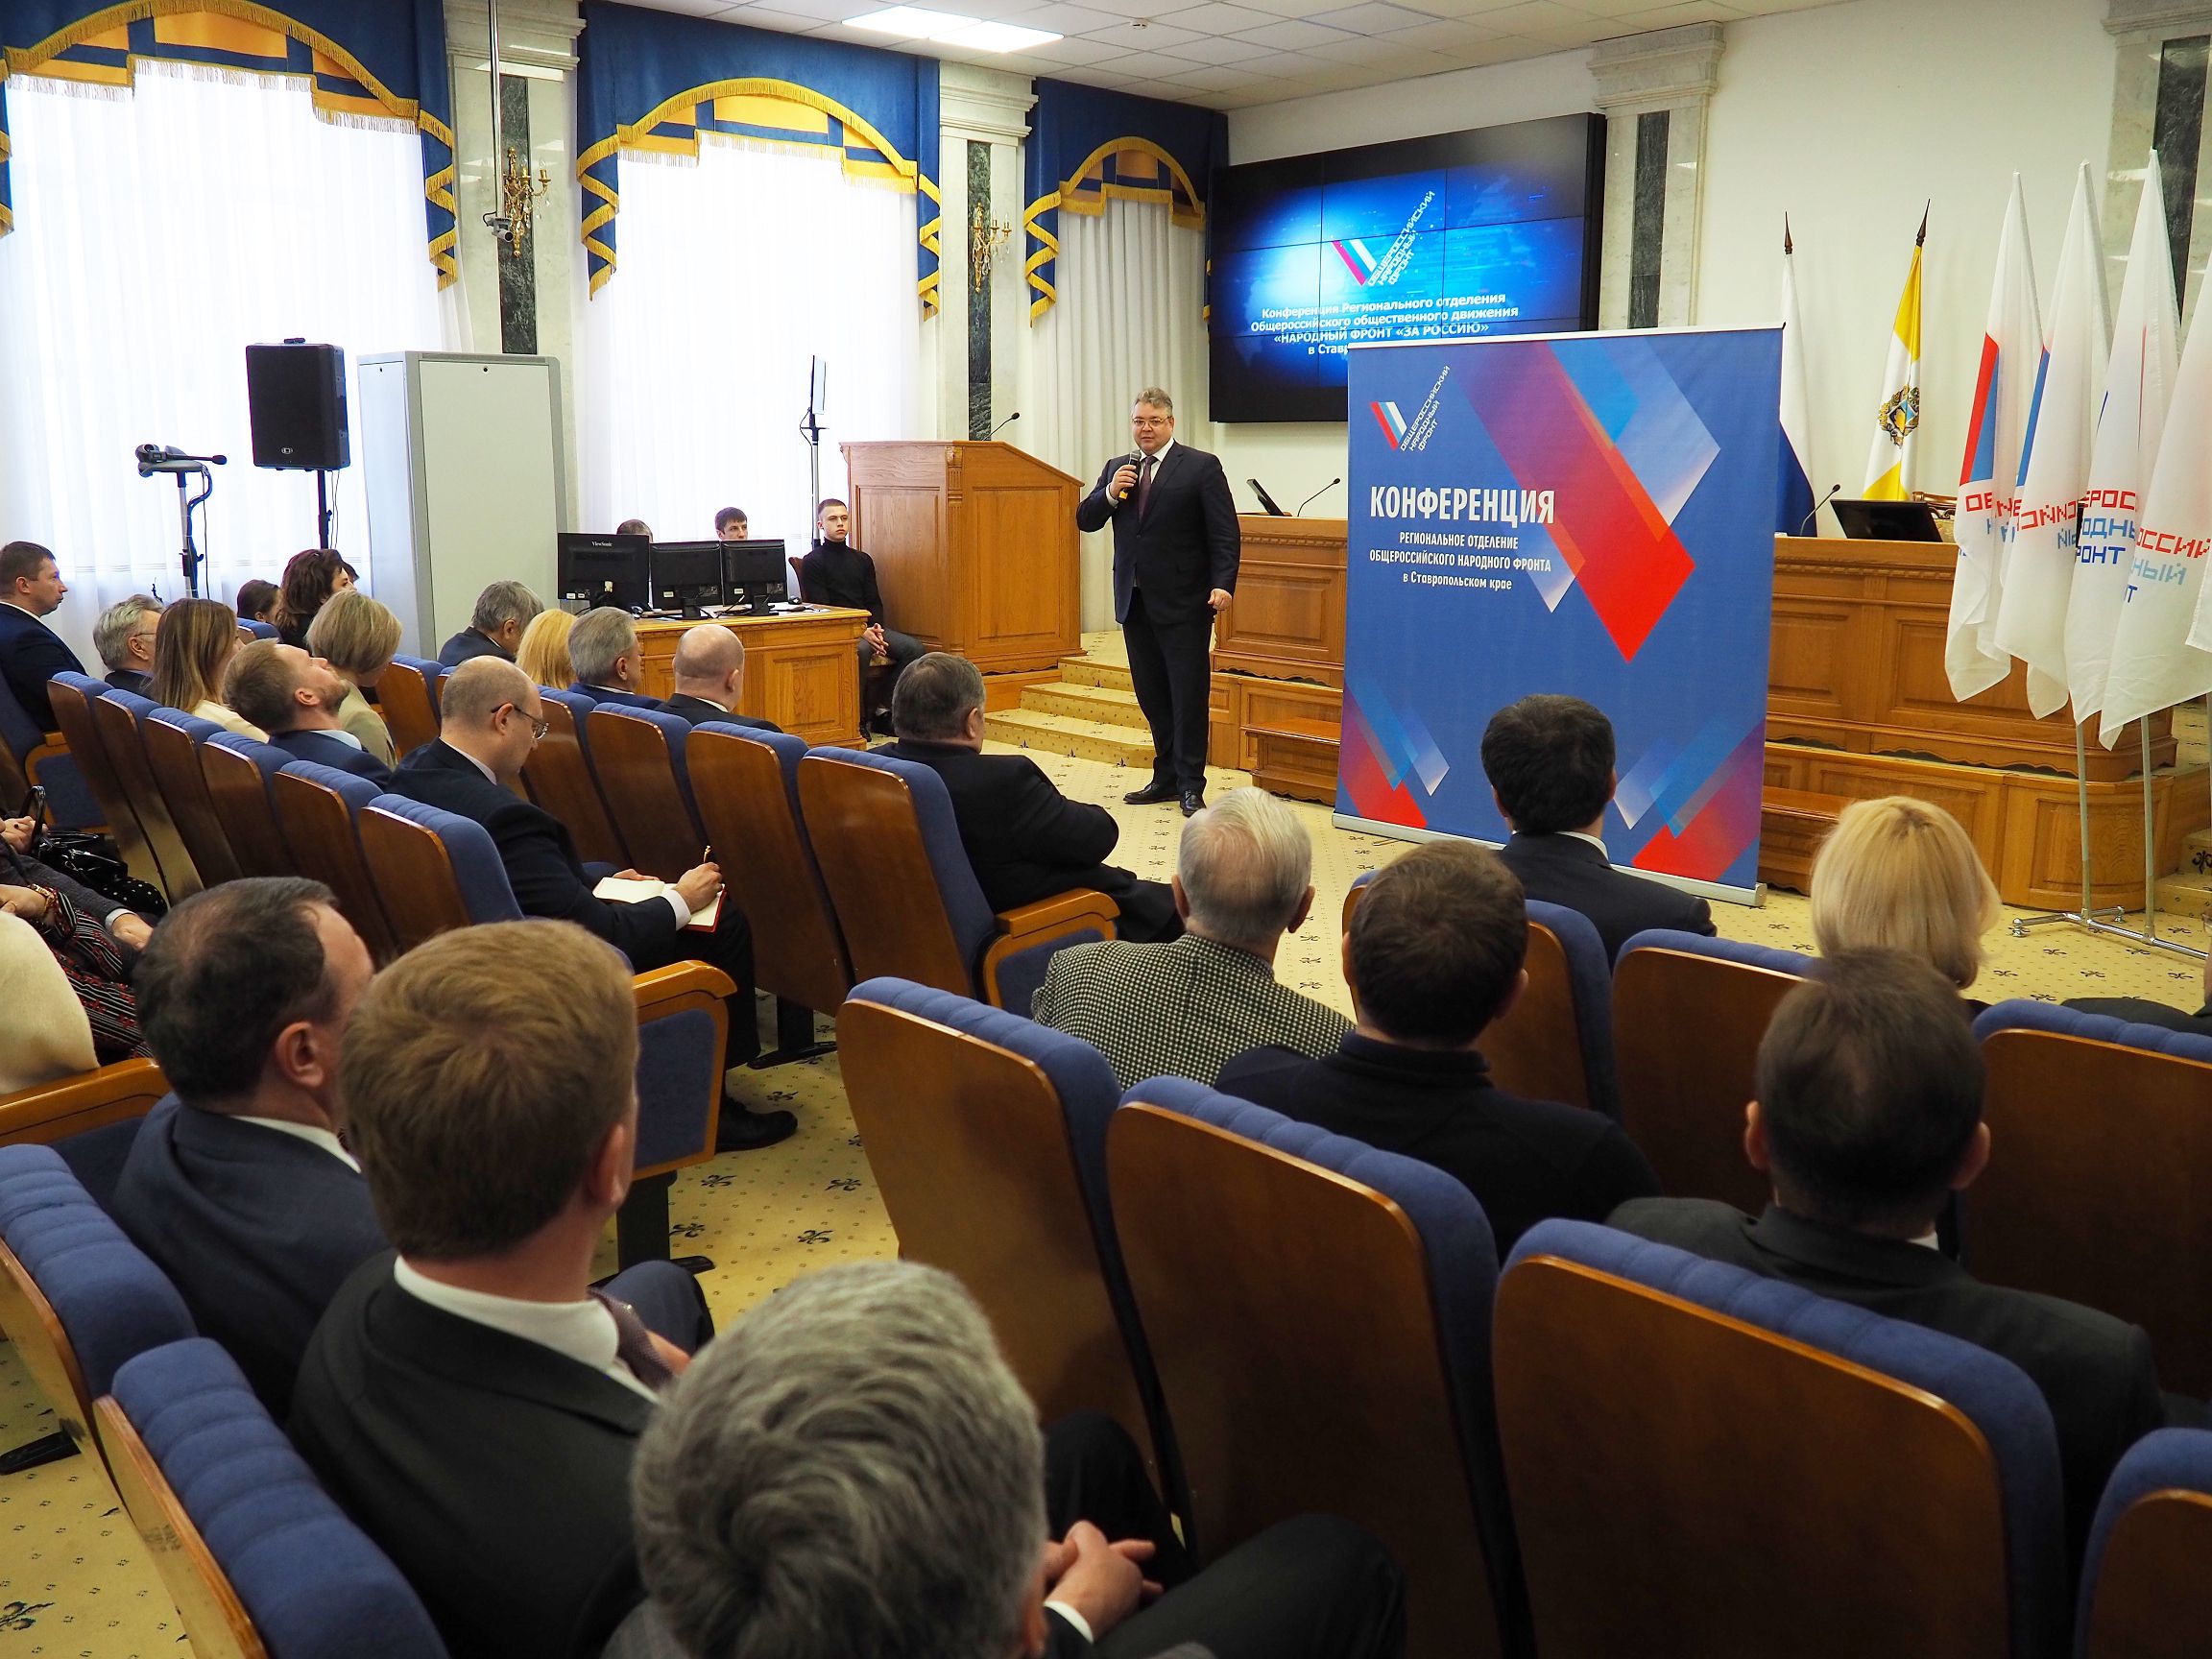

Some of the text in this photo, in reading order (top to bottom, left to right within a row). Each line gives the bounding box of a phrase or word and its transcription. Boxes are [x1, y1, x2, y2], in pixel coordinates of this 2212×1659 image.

[1367, 190, 1435, 286] ОБЩЕРОССИЙСКИЙ
[1387, 249, 1415, 285] ФРОНТ
[1251, 307, 1519, 332] Общероссийского общественного движения
[1262, 293, 1506, 319] Конференция Регионального отделения
[1350, 327, 1393, 339] ФРОНТ
[1400, 365, 1451, 451] ОБЩЕРОССИЙСКИЙ
[1409, 399, 1440, 451] НАРОДНЫЙ
[1418, 419, 1438, 451] ФРОНТ
[1370, 486, 1555, 528] КОНФЕРЕНЦИЯ
[1399, 531, 1519, 550] РЕГИОНАЛЬНОЕ ОТДЕЛЕНИЕ
[1370, 548, 1551, 572] ОБЩЕРОССИЙСКОГО НАРОДНОГО ФРОНТА
[1403, 570, 1512, 592] в Ставропольском крае
